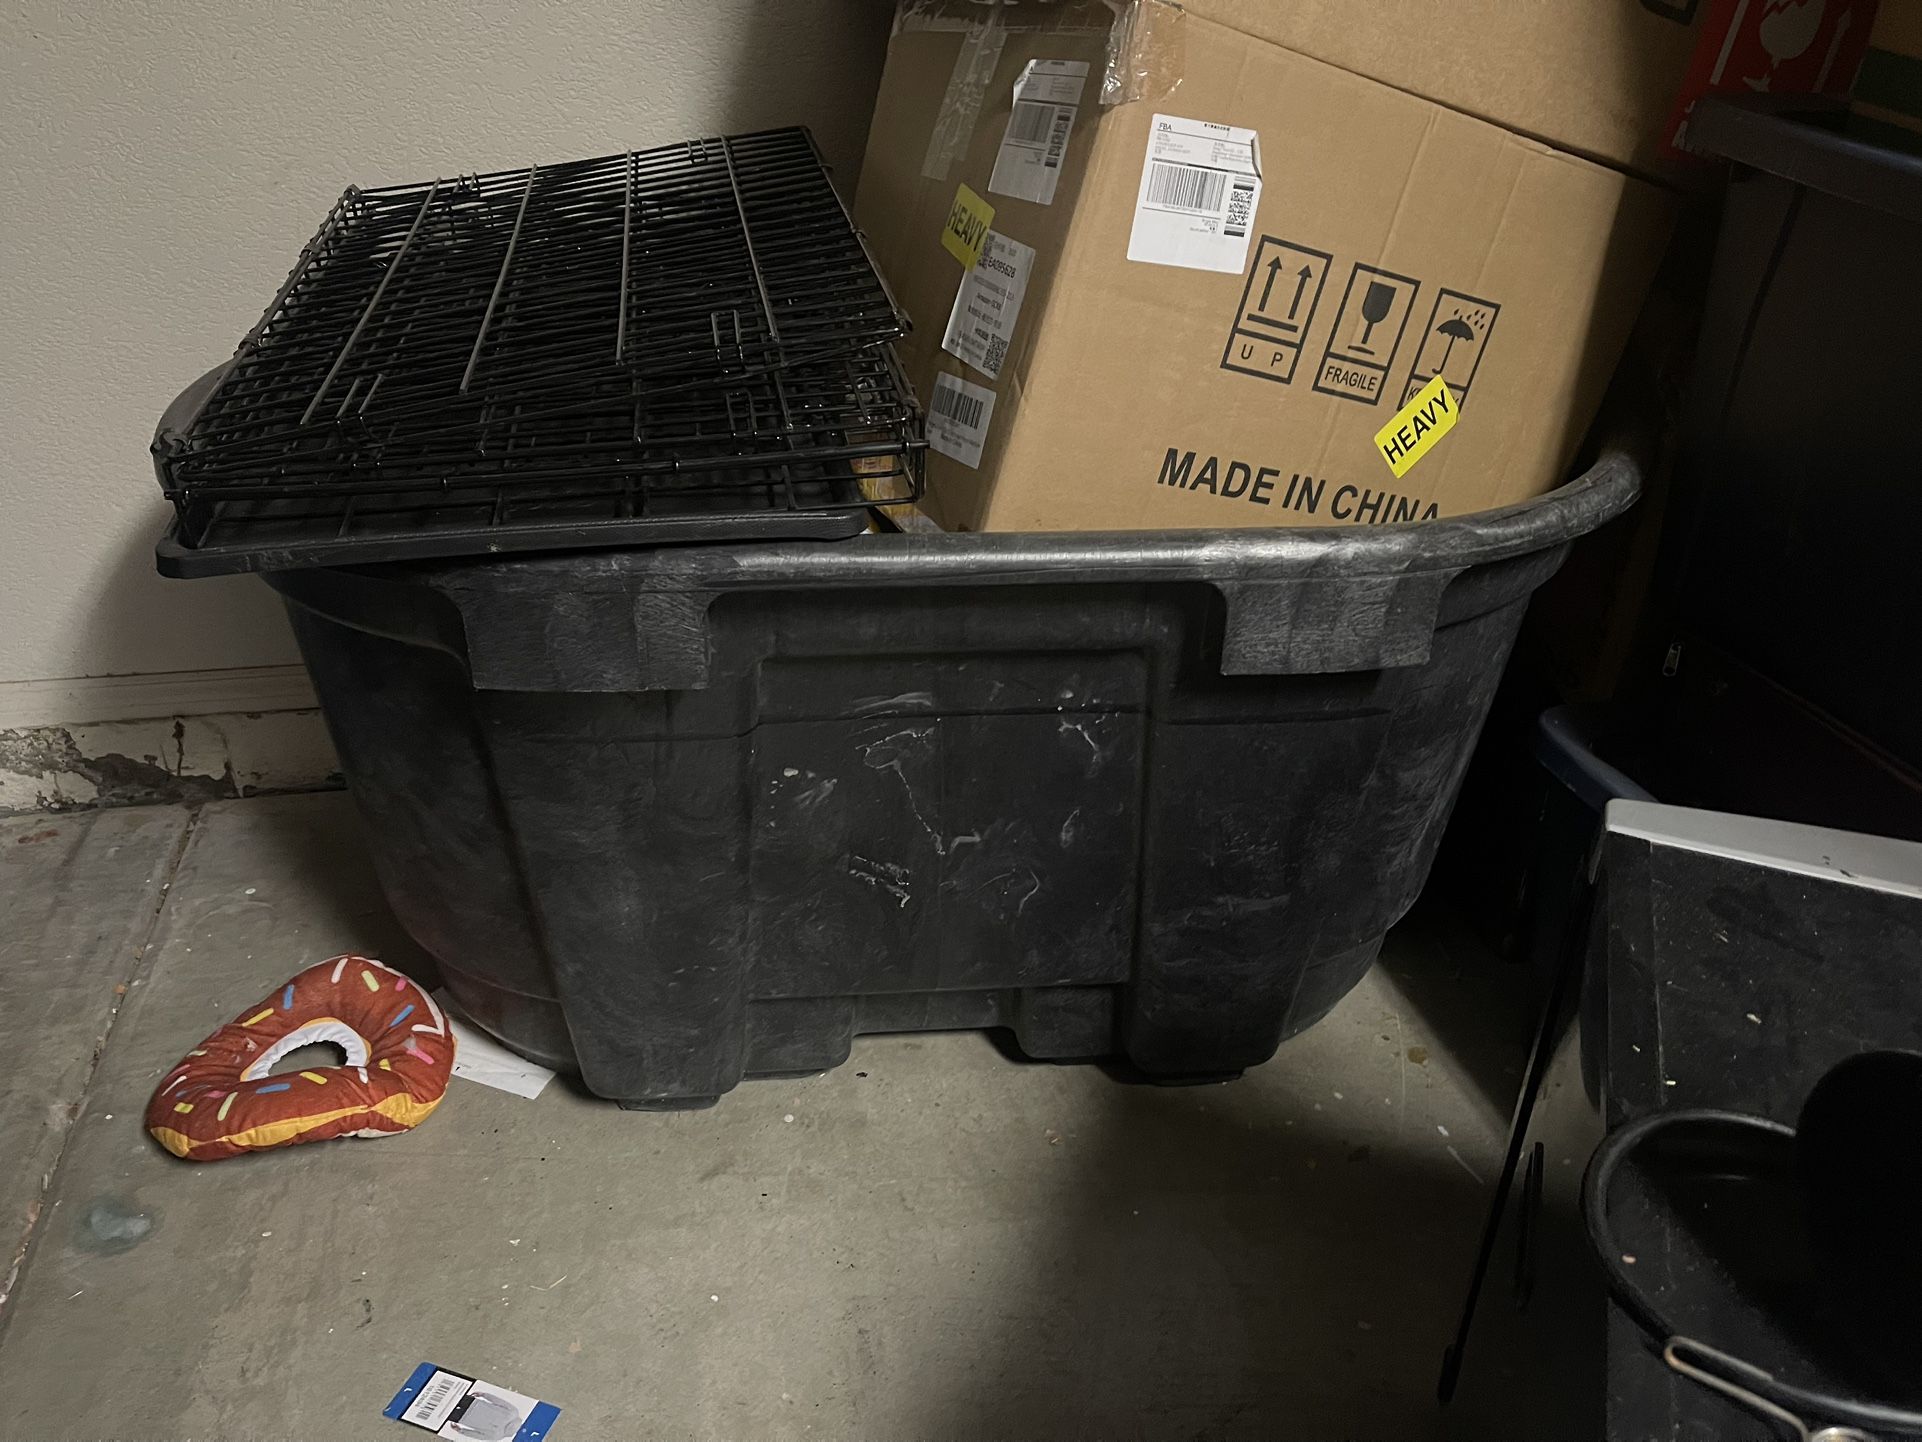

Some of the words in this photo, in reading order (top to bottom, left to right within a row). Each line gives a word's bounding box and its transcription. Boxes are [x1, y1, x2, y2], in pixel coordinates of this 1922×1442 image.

[1158, 122, 1172, 131] FBA
[947, 200, 988, 252] HEAVY
[1324, 365, 1378, 392] FRAGILE
[1383, 388, 1449, 465] HEAVY
[1157, 447, 1280, 505] MADE
[1282, 473, 1326, 514] IN
[1331, 484, 1438, 524] CHINA
